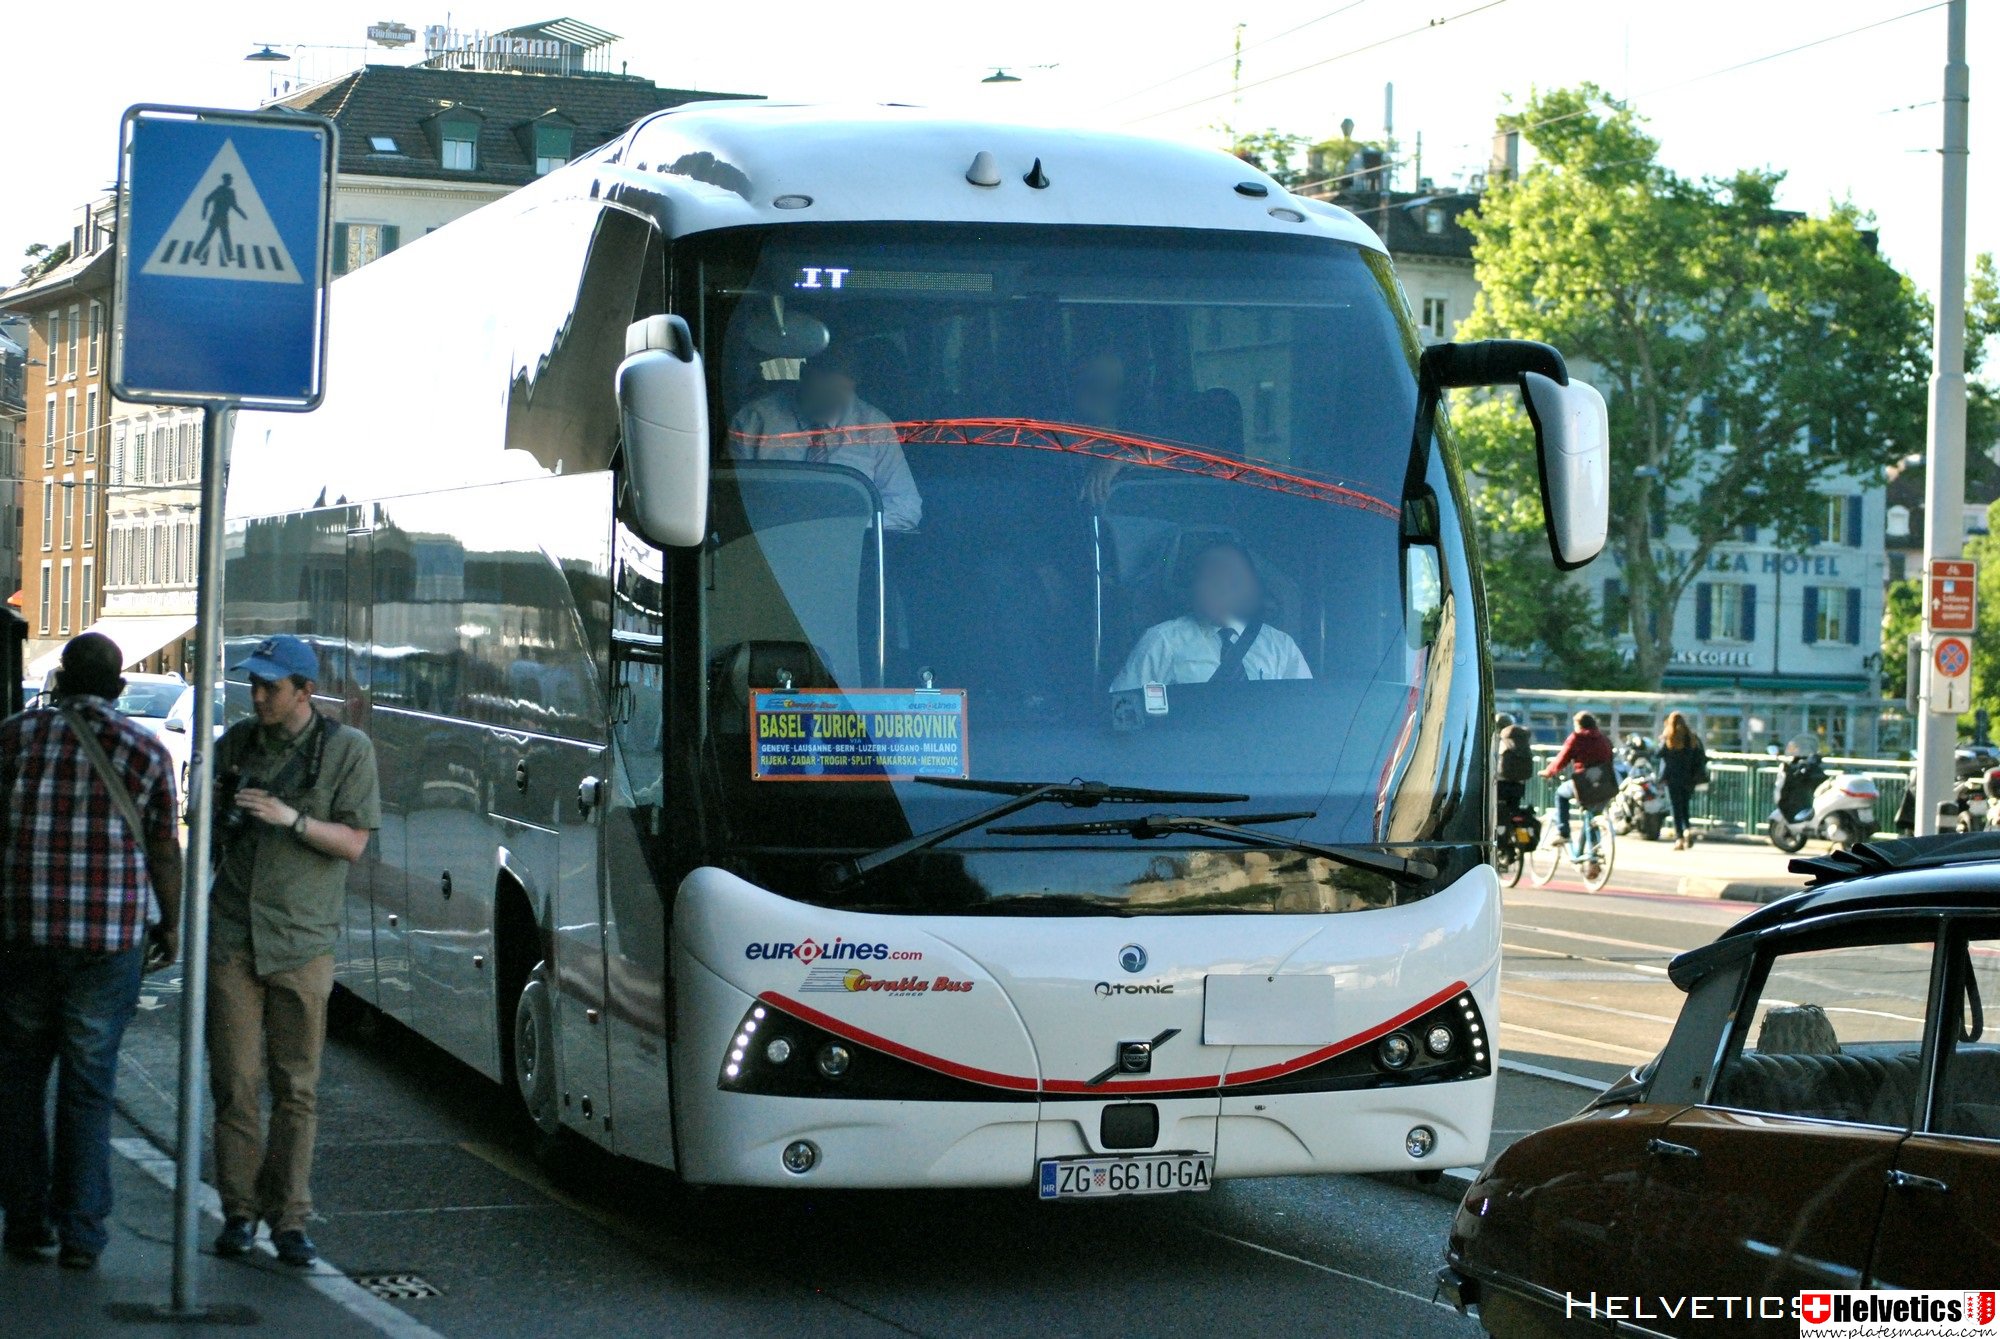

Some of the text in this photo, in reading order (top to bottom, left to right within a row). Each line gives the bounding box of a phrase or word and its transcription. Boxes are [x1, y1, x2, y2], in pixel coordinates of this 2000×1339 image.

[1762, 553, 1840, 576] HOTEL
[760, 714, 958, 738] BASEL ZURICH DUBROVNIK
[931, 976, 975, 992] Bus
[1042, 1185, 1056, 1193] HR
[1060, 1165, 1091, 1193] ZG
